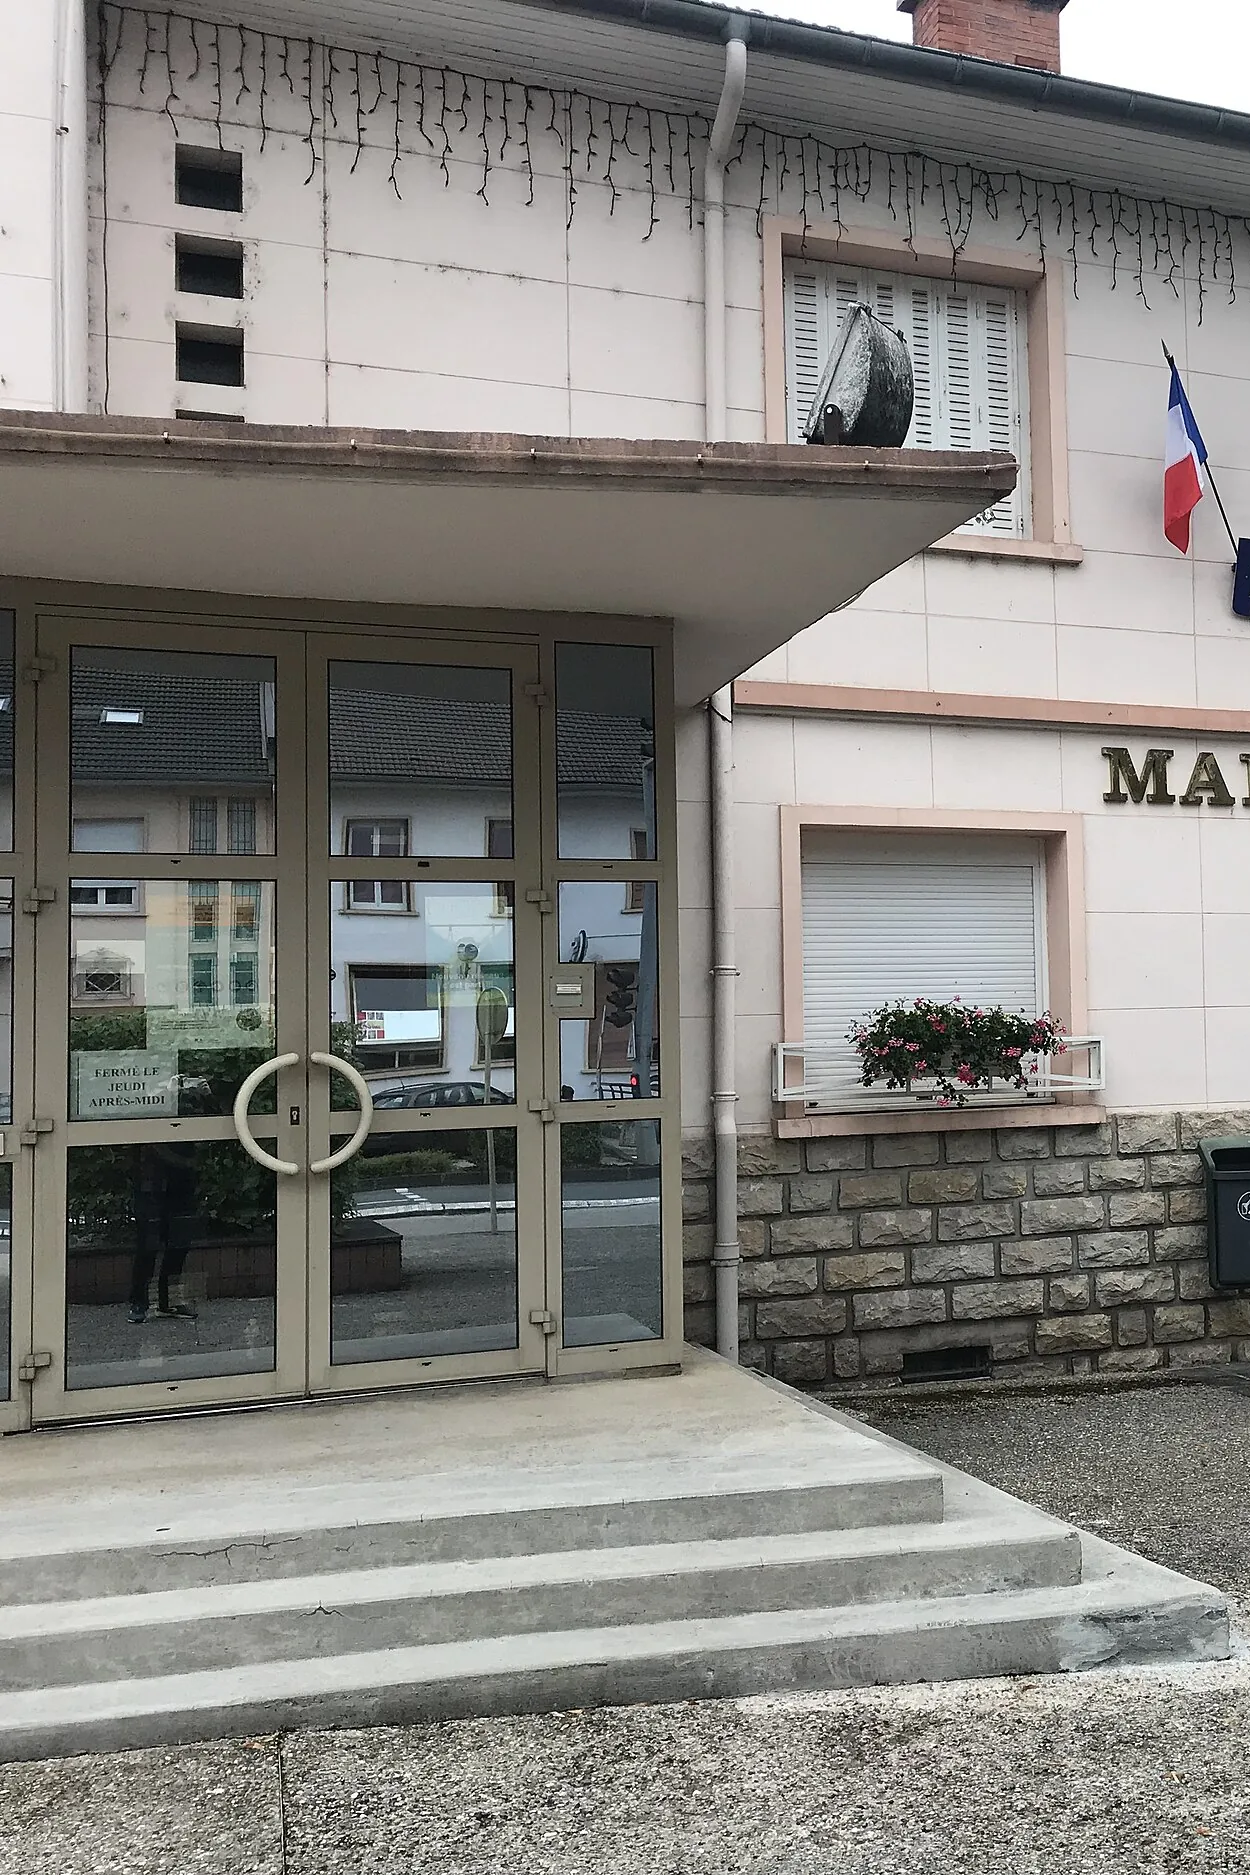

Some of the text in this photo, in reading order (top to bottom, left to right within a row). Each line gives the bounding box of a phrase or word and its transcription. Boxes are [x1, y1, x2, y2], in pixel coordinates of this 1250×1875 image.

[95, 1066, 160, 1078] FERMÉ LE
[108, 1082, 146, 1092] JEUDI
[89, 1095, 165, 1107] APRÈS-MIDI
